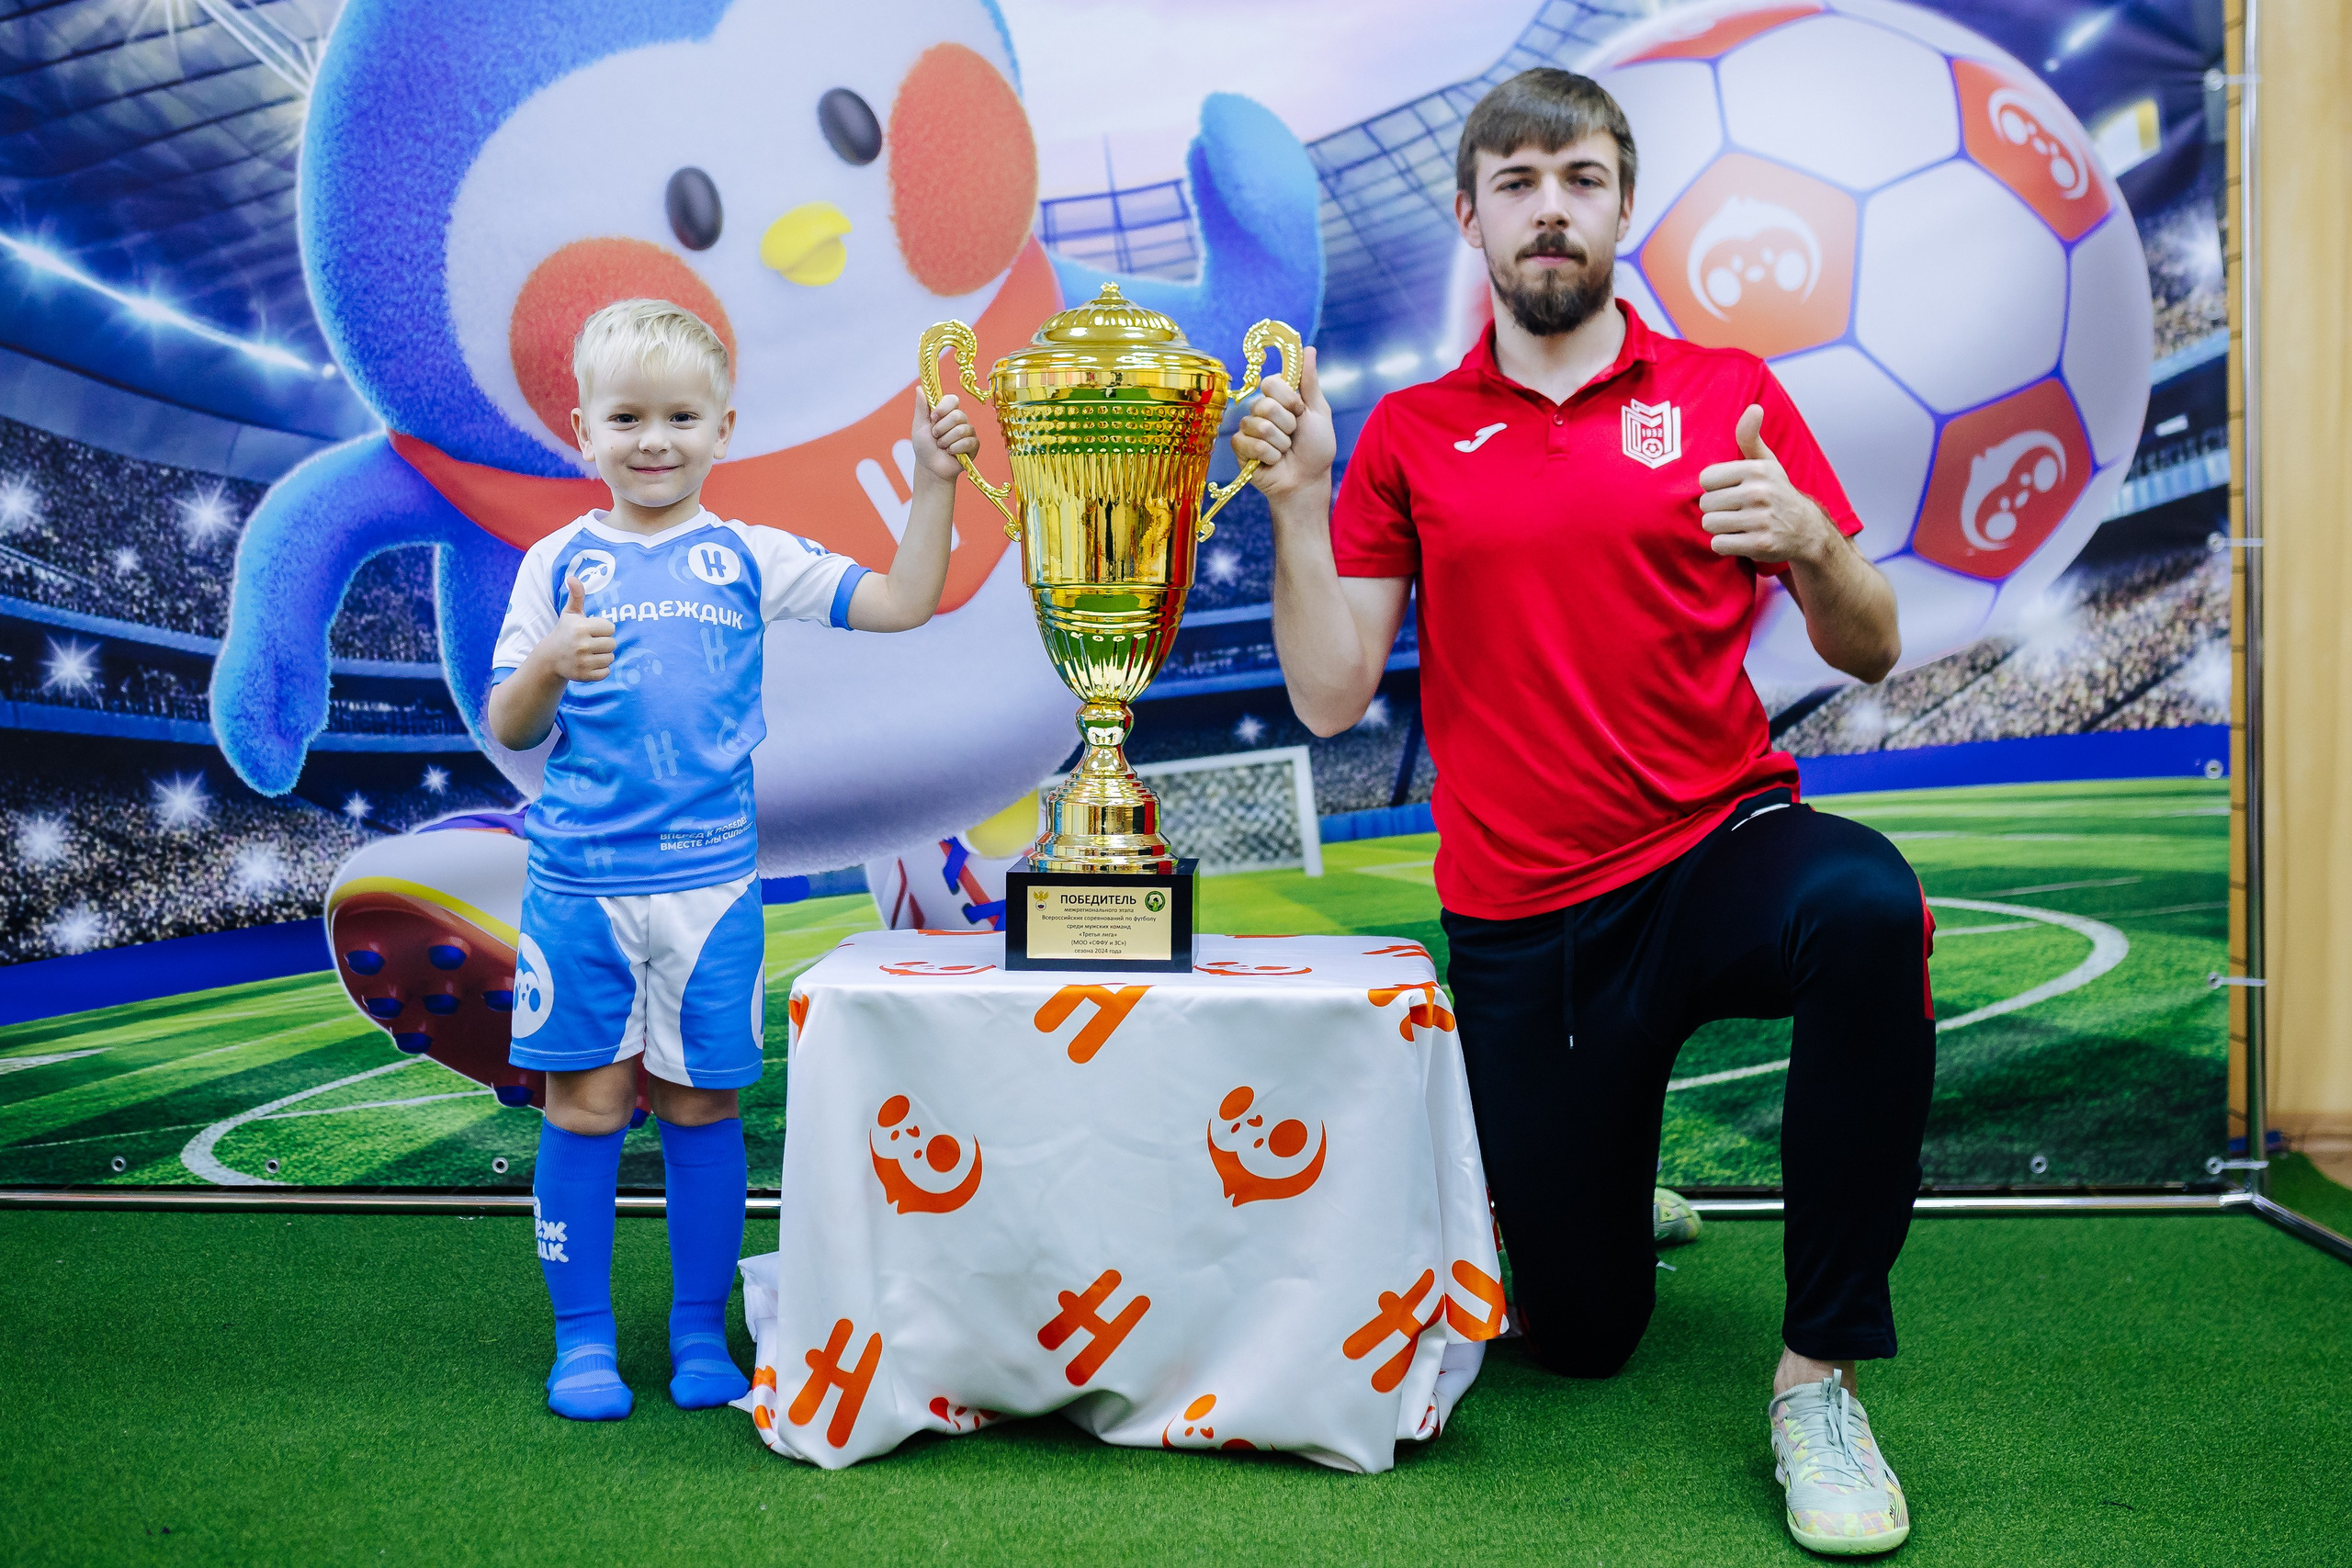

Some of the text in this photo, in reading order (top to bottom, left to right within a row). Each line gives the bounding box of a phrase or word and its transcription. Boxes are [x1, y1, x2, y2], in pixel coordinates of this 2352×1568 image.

[601, 600, 743, 630] НАДЕЖДИК
[660, 839, 703, 852] ВМЕСТЕ
[705, 836, 722, 846] МЫ
[1060, 894, 1136, 906] ПОБЕДИТЕЛЬ
